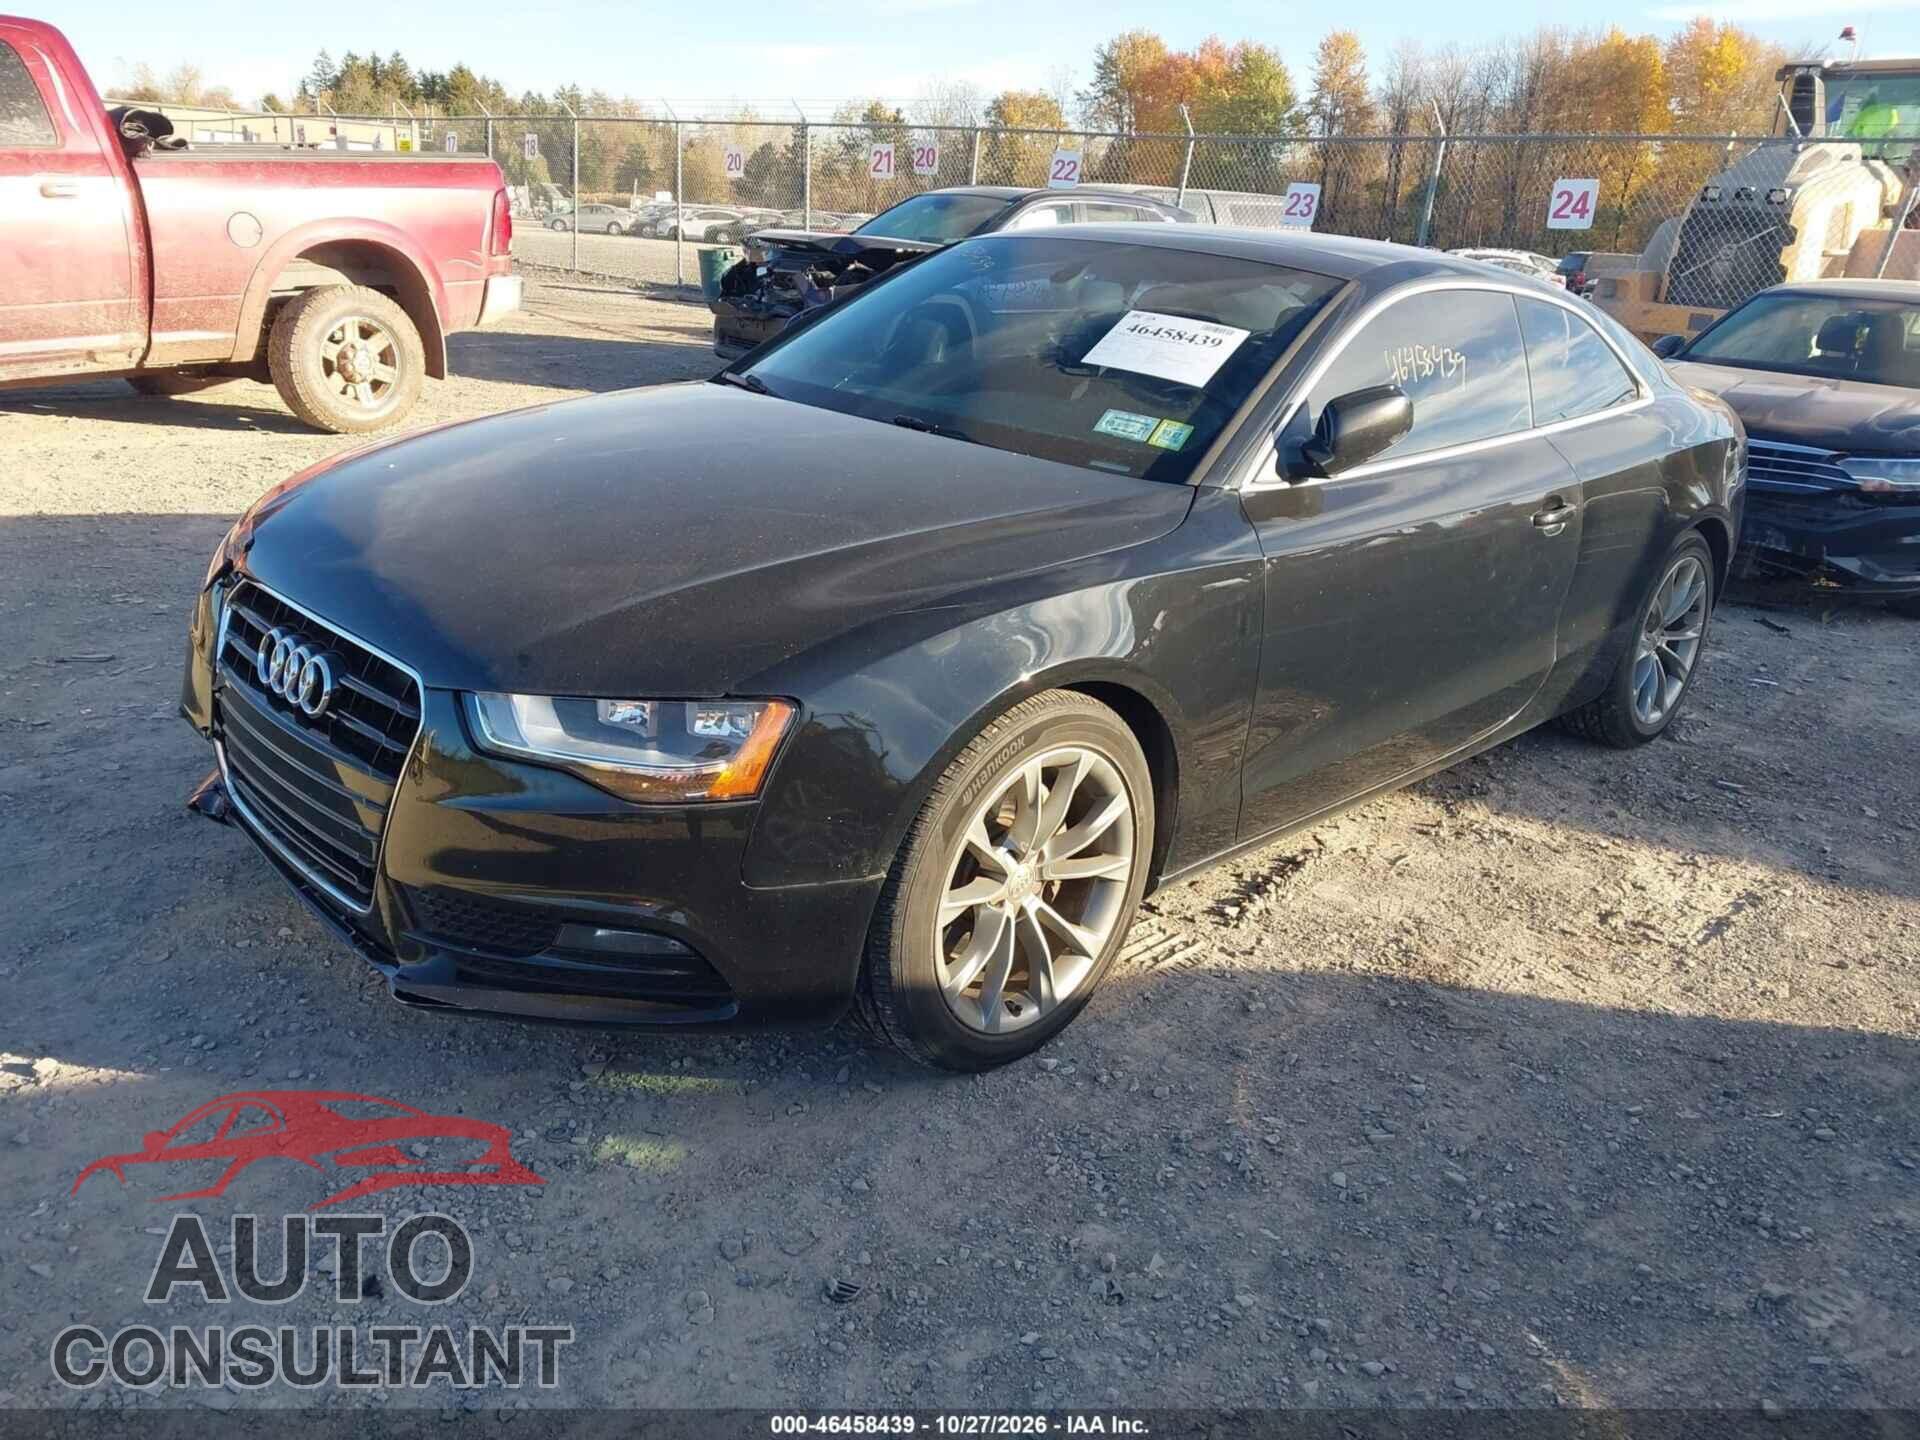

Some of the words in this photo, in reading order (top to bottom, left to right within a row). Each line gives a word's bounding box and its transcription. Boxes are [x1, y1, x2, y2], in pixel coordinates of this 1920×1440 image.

[526, 138, 537, 157] 18
[915, 147, 936, 168] 20
[727, 153, 742, 172] 20
[872, 149, 893, 173] 21
[1051, 158, 1078, 181] 22
[1284, 191, 1316, 218] 23
[1551, 189, 1591, 220] 24
[1125, 322, 1224, 349] 46458439
